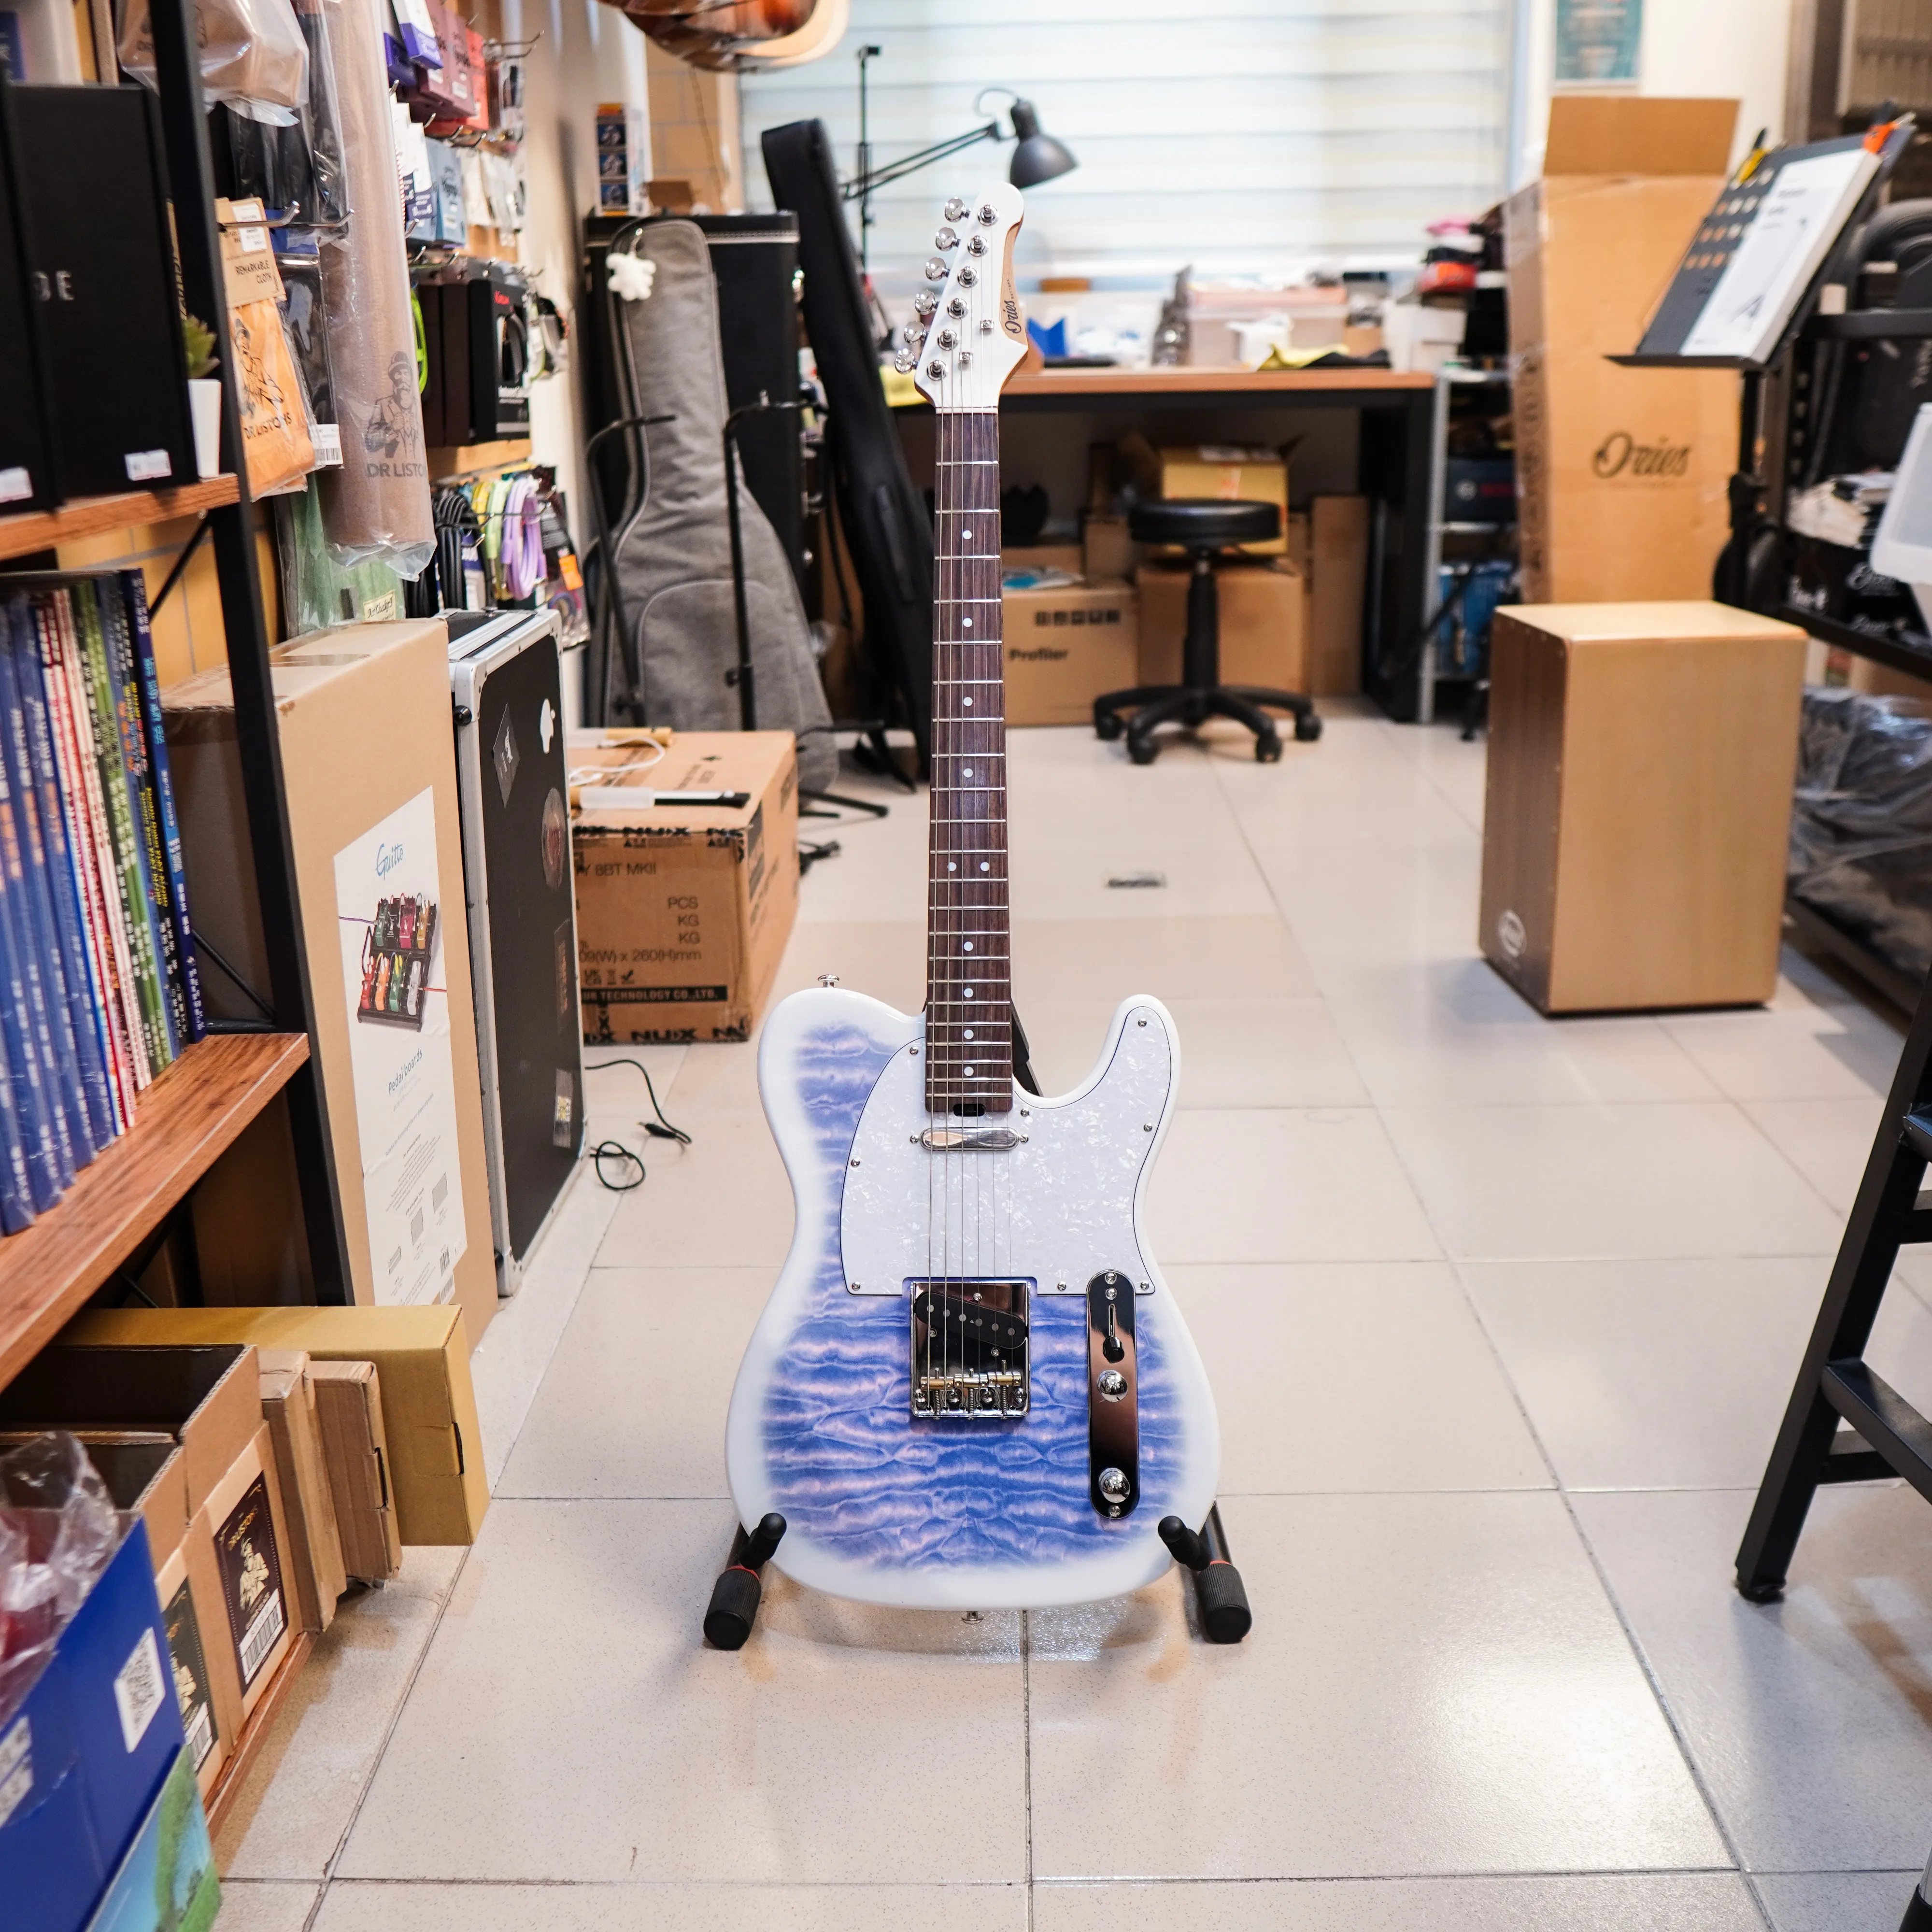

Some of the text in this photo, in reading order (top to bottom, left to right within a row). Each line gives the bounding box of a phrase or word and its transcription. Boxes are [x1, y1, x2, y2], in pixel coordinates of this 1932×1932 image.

[235, 260, 270, 276] REMARKABLE
[256, 272, 272, 284] CLOTH
[367, 462, 391, 478] DR
[595, 863, 622, 877] 8BT
[626, 862, 657, 876] MKII
[668, 896, 698, 909] PCS
[678, 914, 699, 927] KG
[679, 931, 700, 944] KG
[600, 989, 670, 1001] TECHNOLOGY
[388, 1066, 404, 1095] Pedal
[404, 1048, 423, 1077] boards
